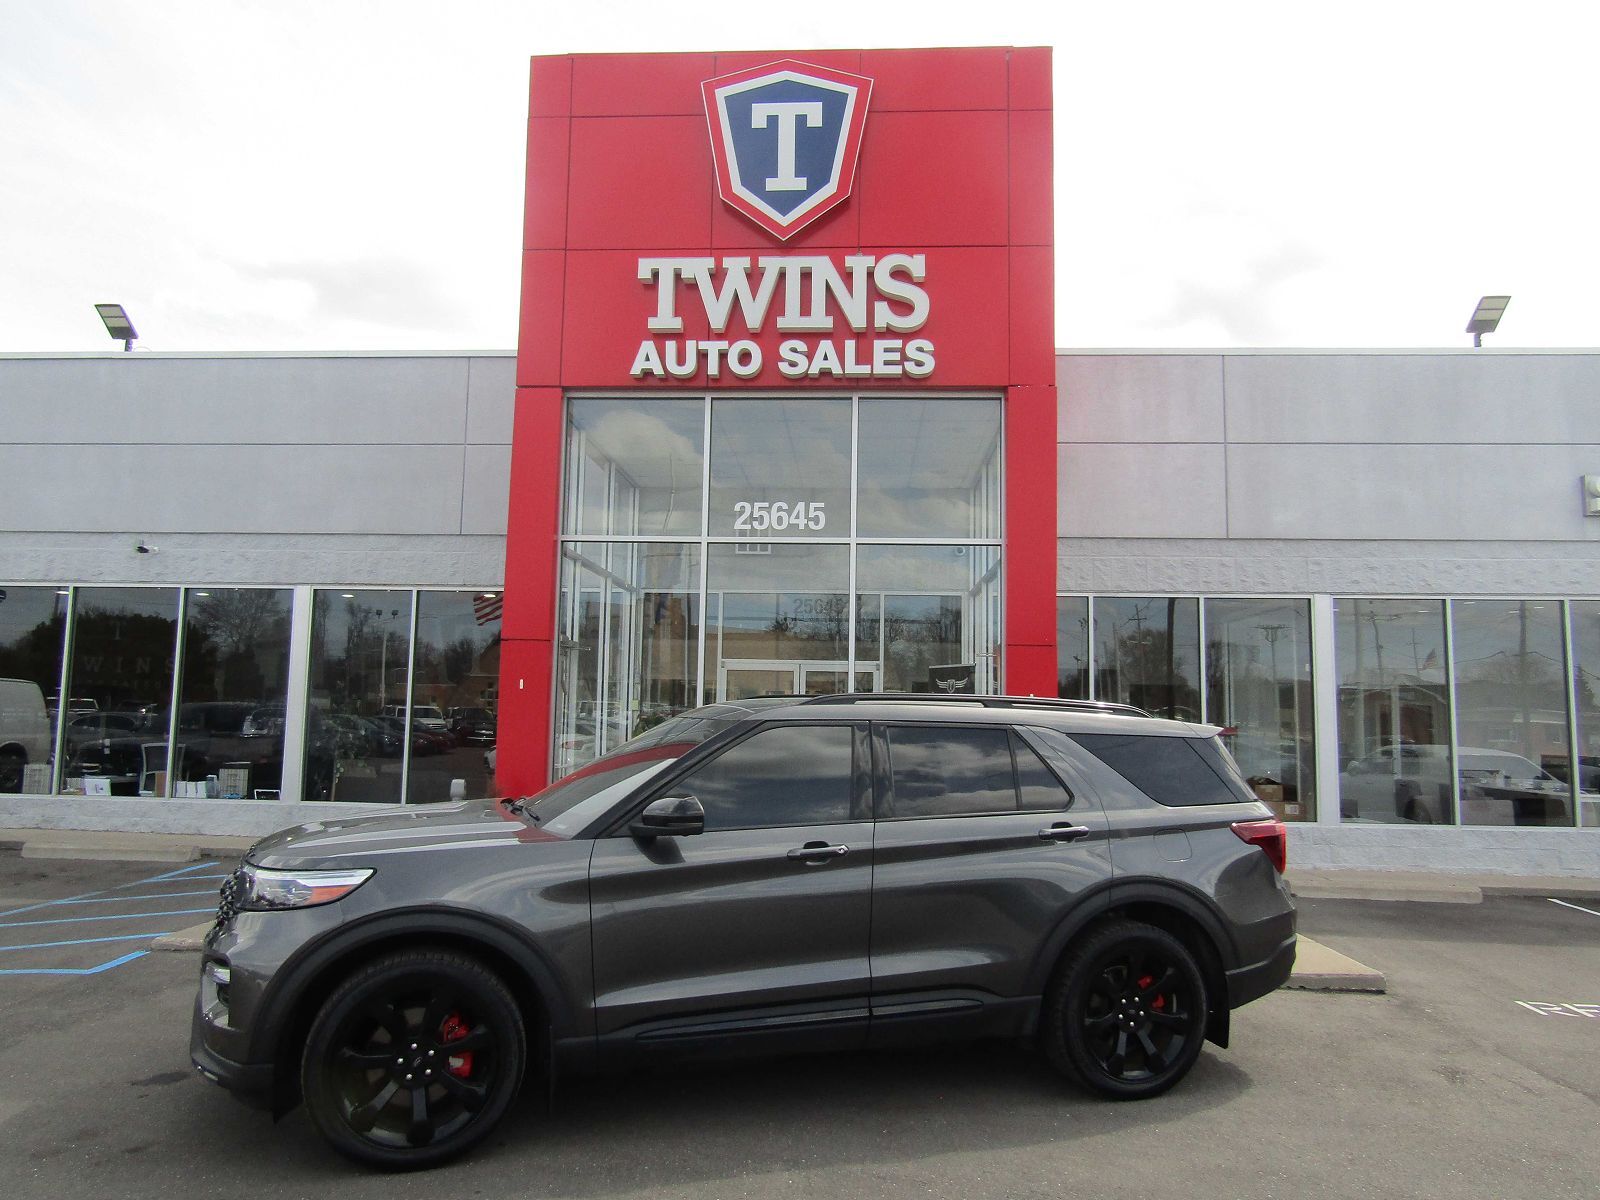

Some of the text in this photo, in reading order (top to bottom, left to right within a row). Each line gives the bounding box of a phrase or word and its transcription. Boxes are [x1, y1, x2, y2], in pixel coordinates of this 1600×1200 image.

[751, 102, 823, 191] T
[637, 253, 931, 335] TWINS
[629, 338, 936, 378] AUTO SALES
[733, 501, 826, 530] 25645
